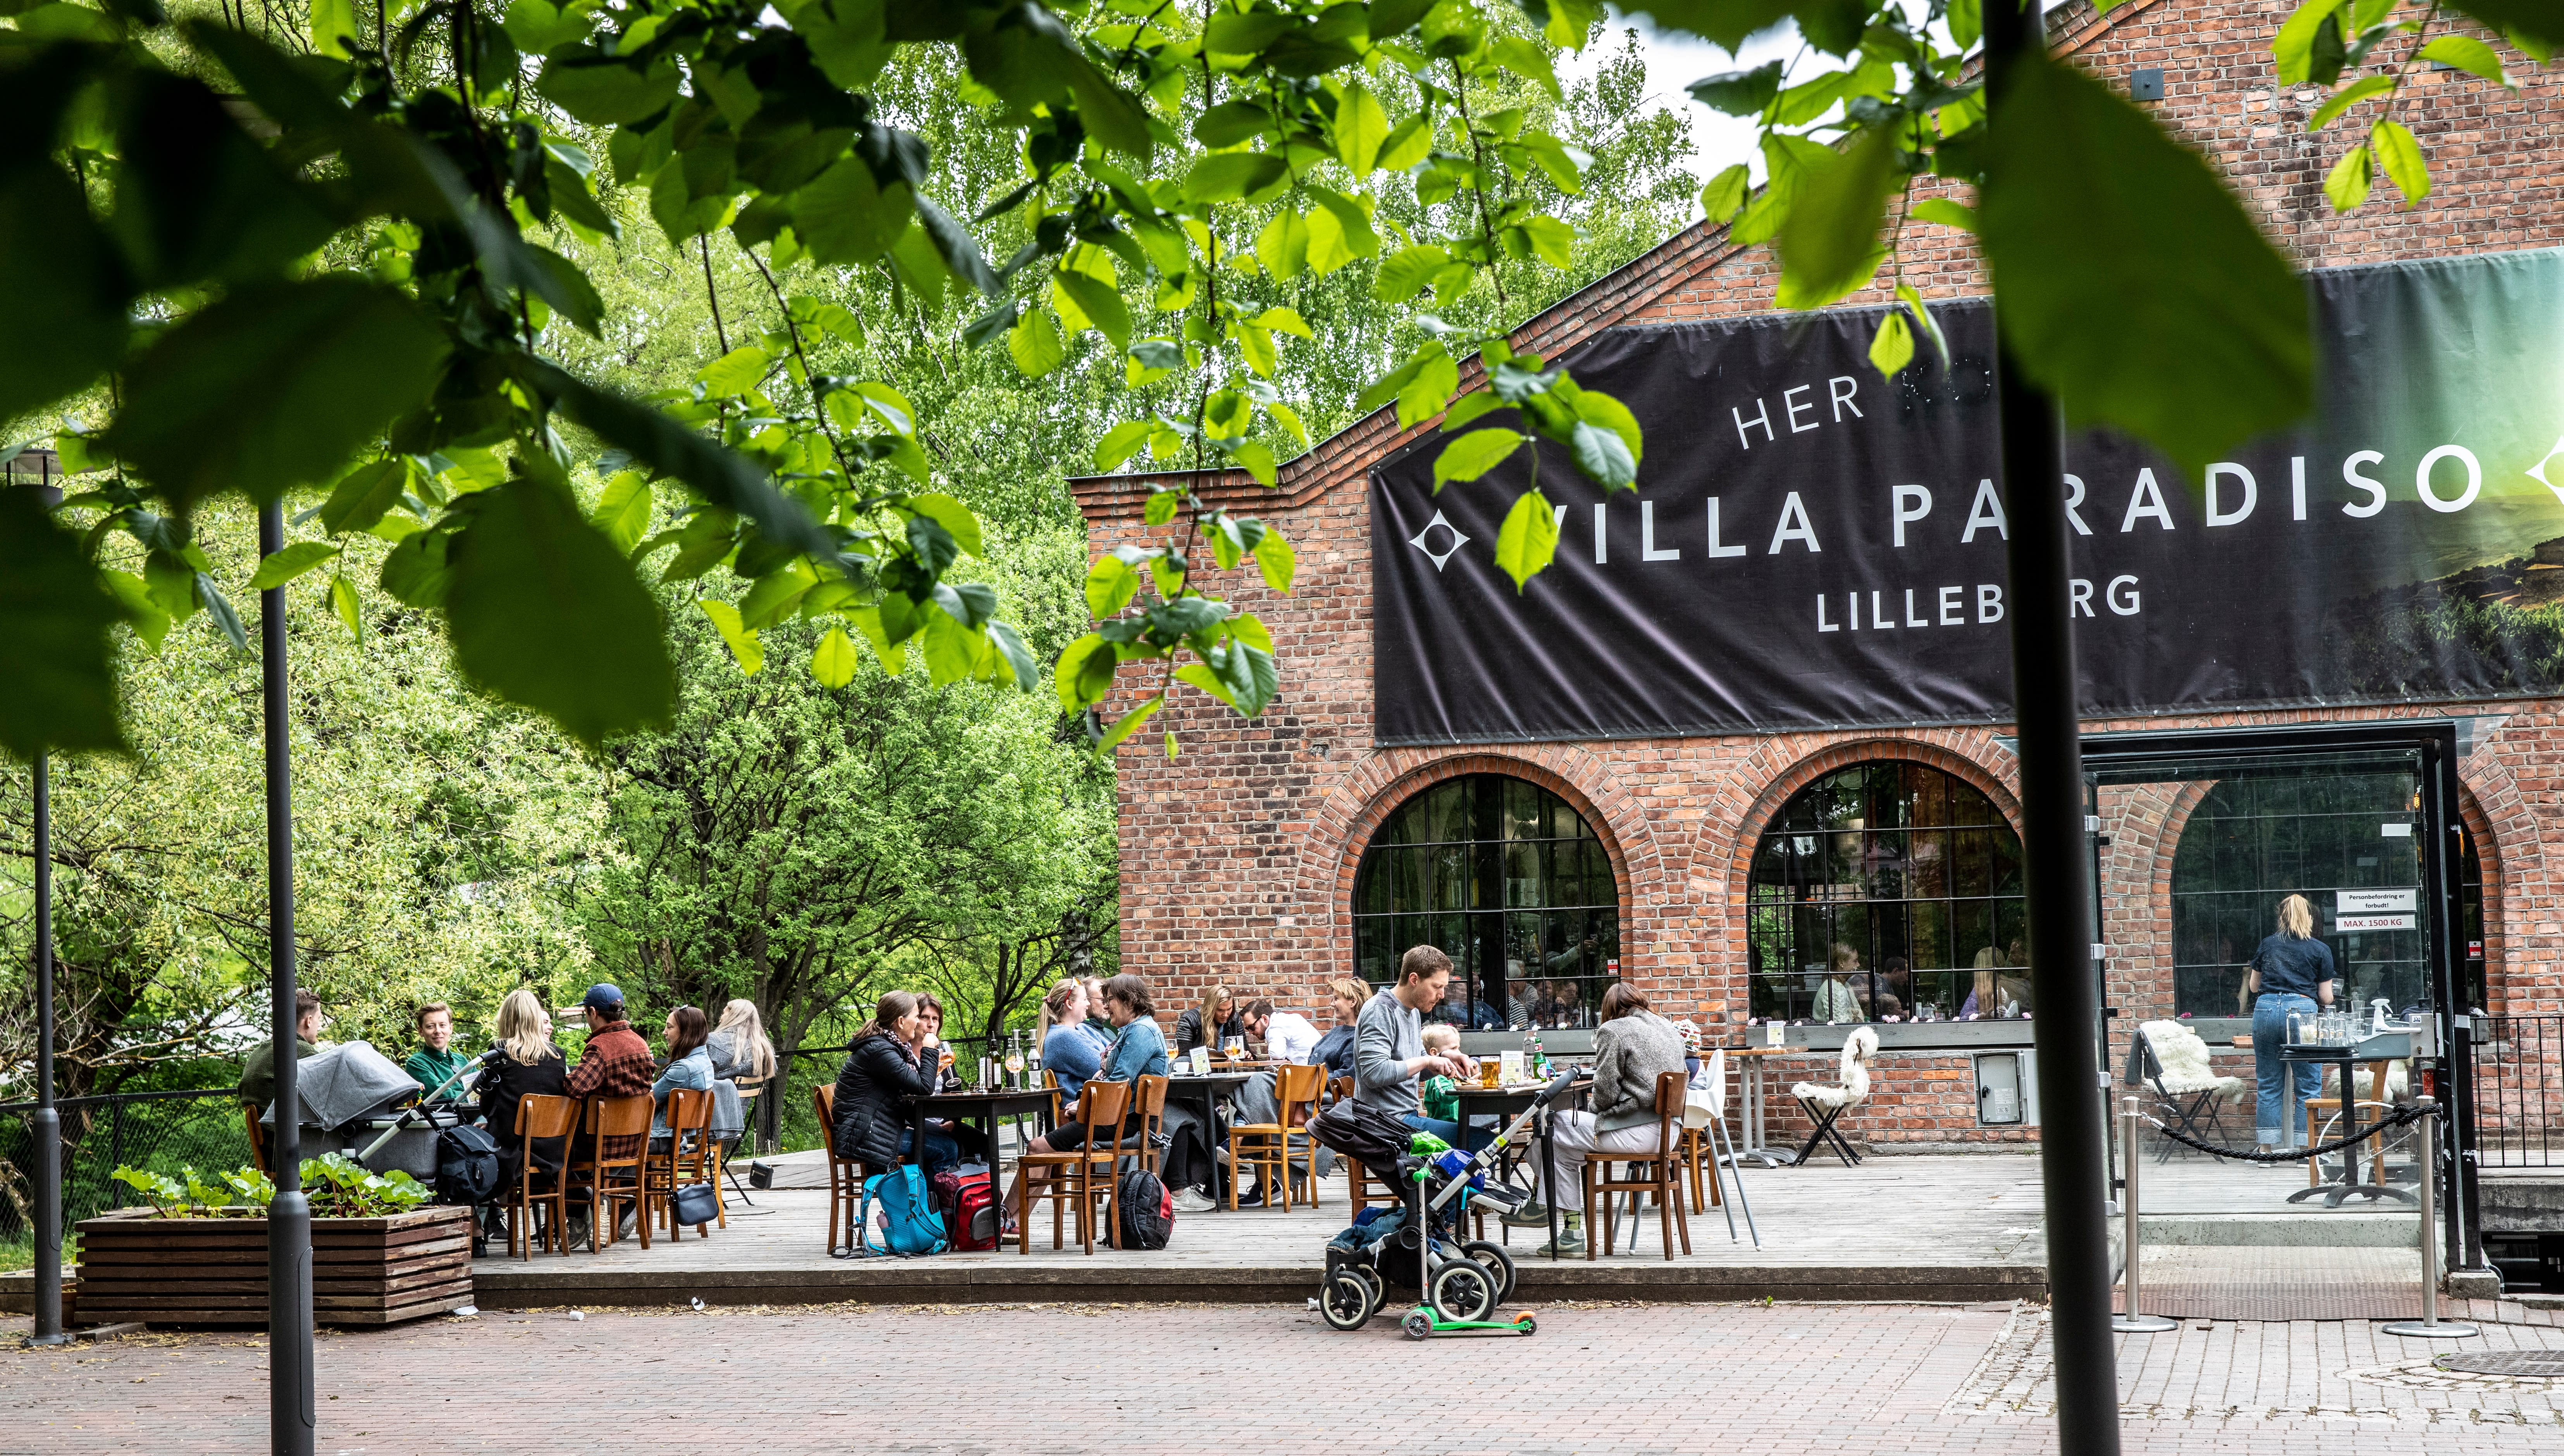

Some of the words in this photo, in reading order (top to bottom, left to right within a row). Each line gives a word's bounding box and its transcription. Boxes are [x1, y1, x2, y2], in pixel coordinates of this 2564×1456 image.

[1732, 376, 1864, 450] HER
[1892, 444, 2482, 547] PARADISO
[1817, 575, 2141, 632] LILLEBRG
